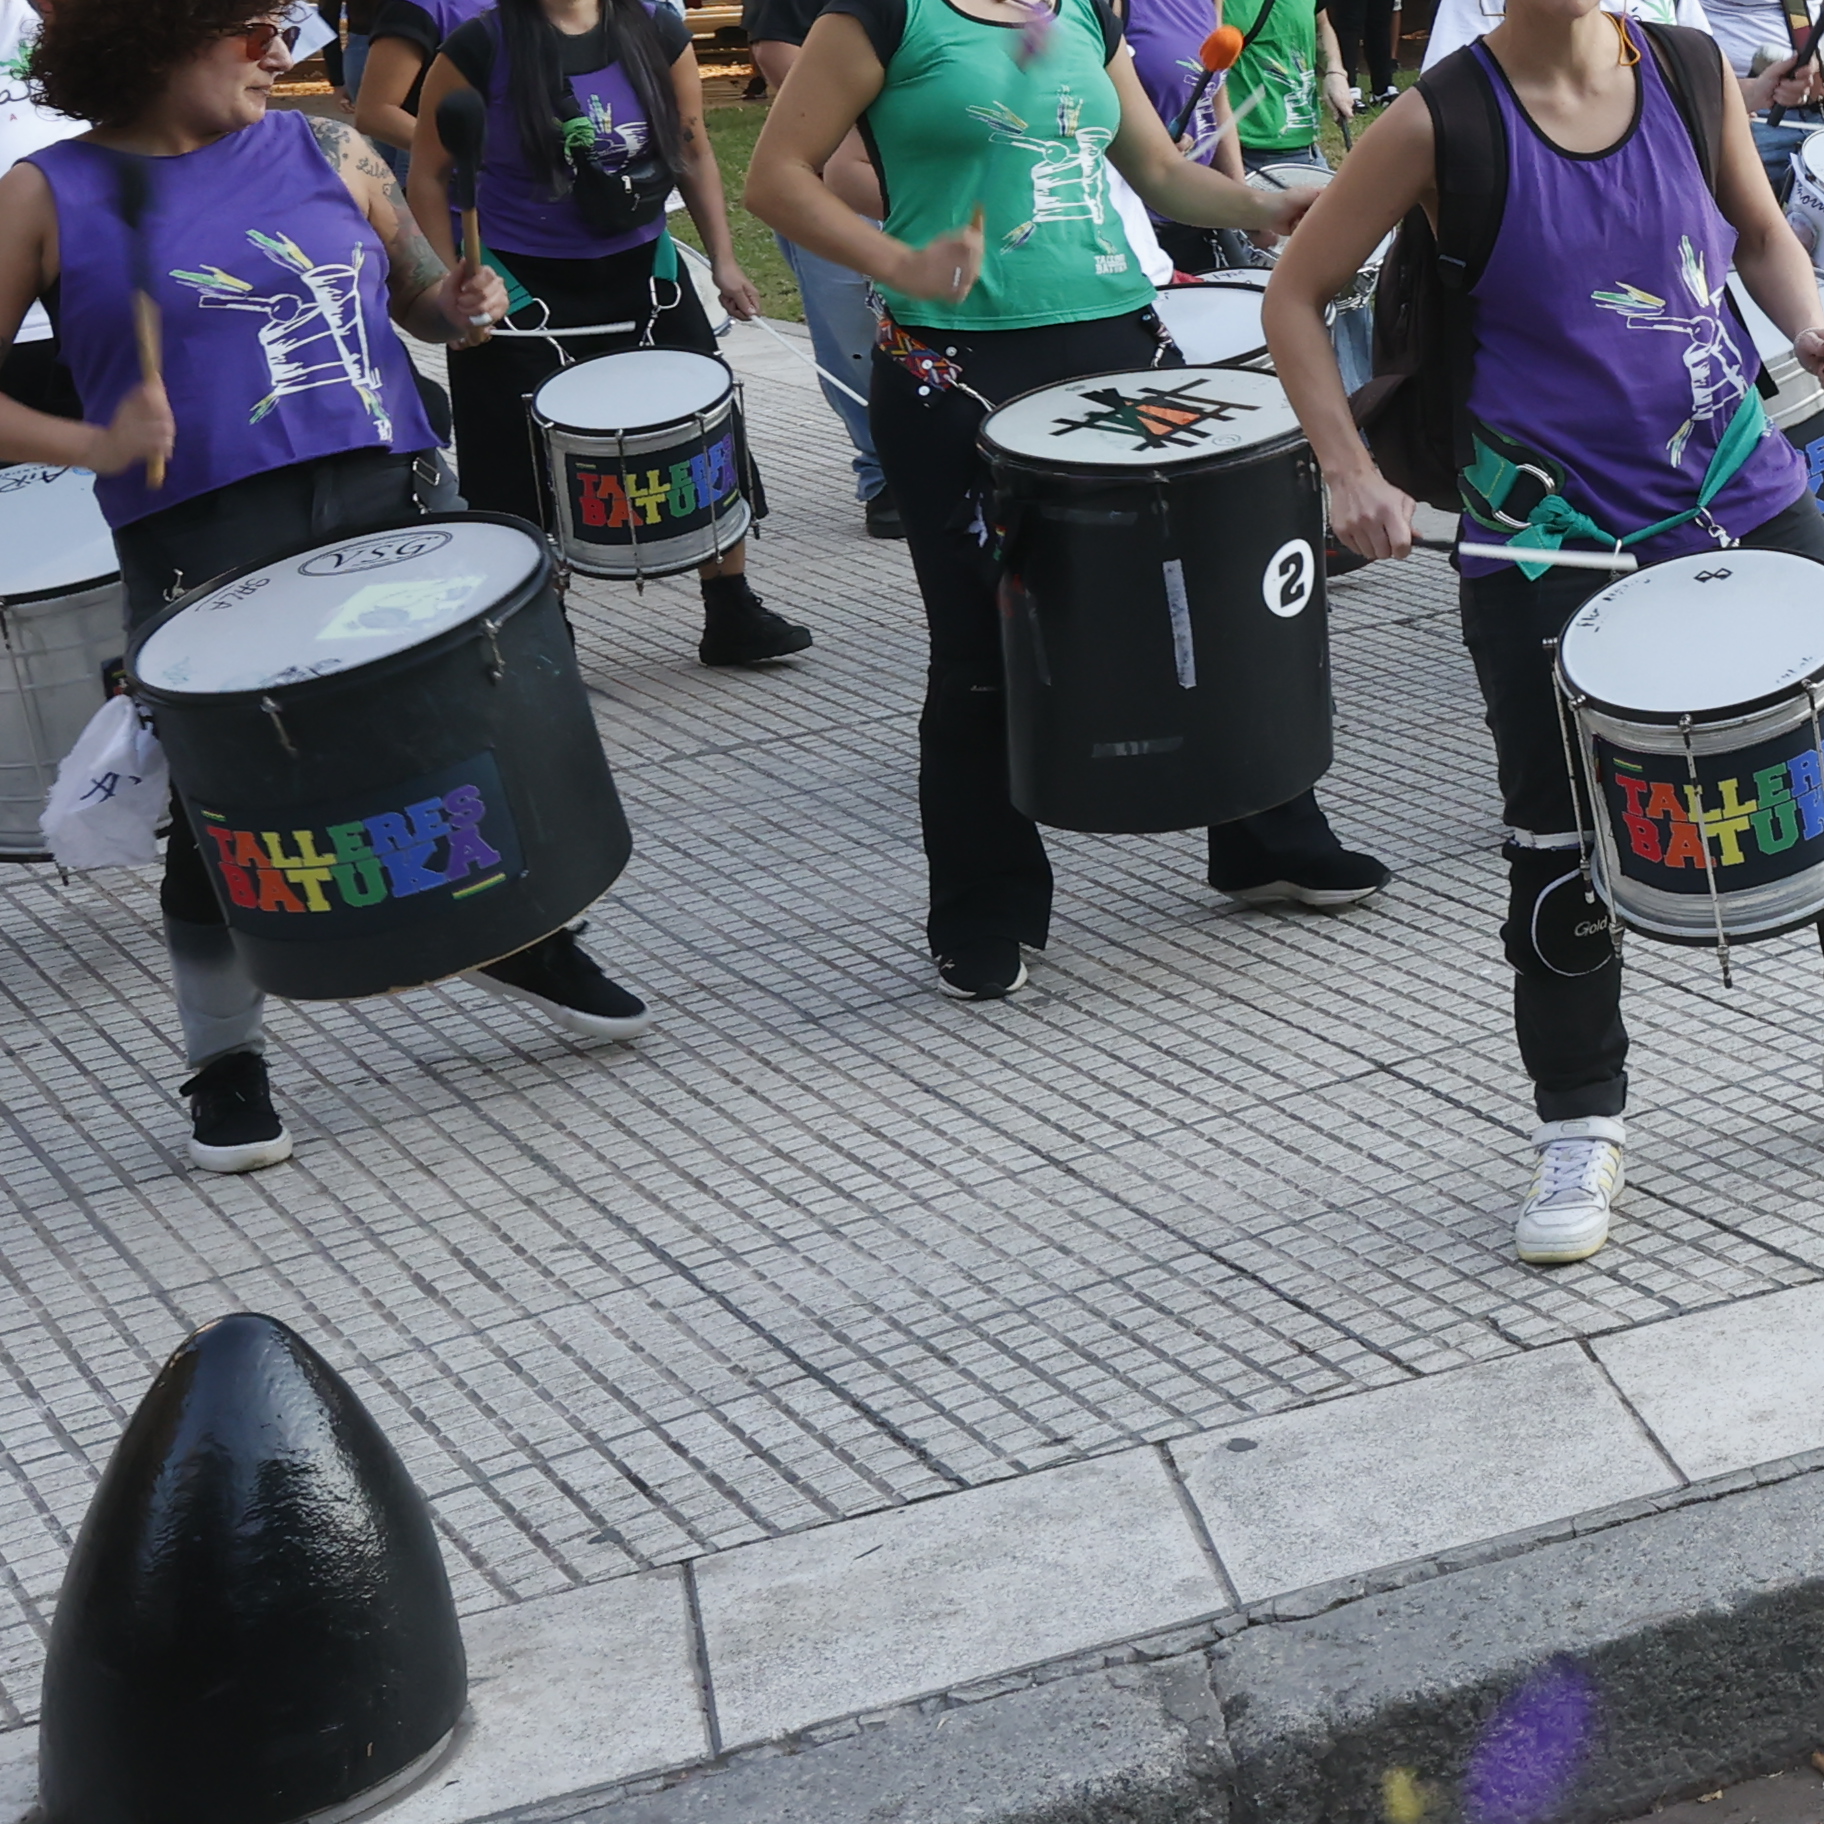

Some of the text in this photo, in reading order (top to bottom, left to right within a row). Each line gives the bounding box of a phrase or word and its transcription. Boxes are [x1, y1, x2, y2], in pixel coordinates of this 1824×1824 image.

[576, 432, 733, 500] TALLERES
[579, 458, 738, 528] BATUKA
[1278, 551, 1306, 609] 2
[205, 784, 487, 870] TALLERES
[217, 826, 502, 913] BATUKA
[1574, 915, 1608, 937] Gold
